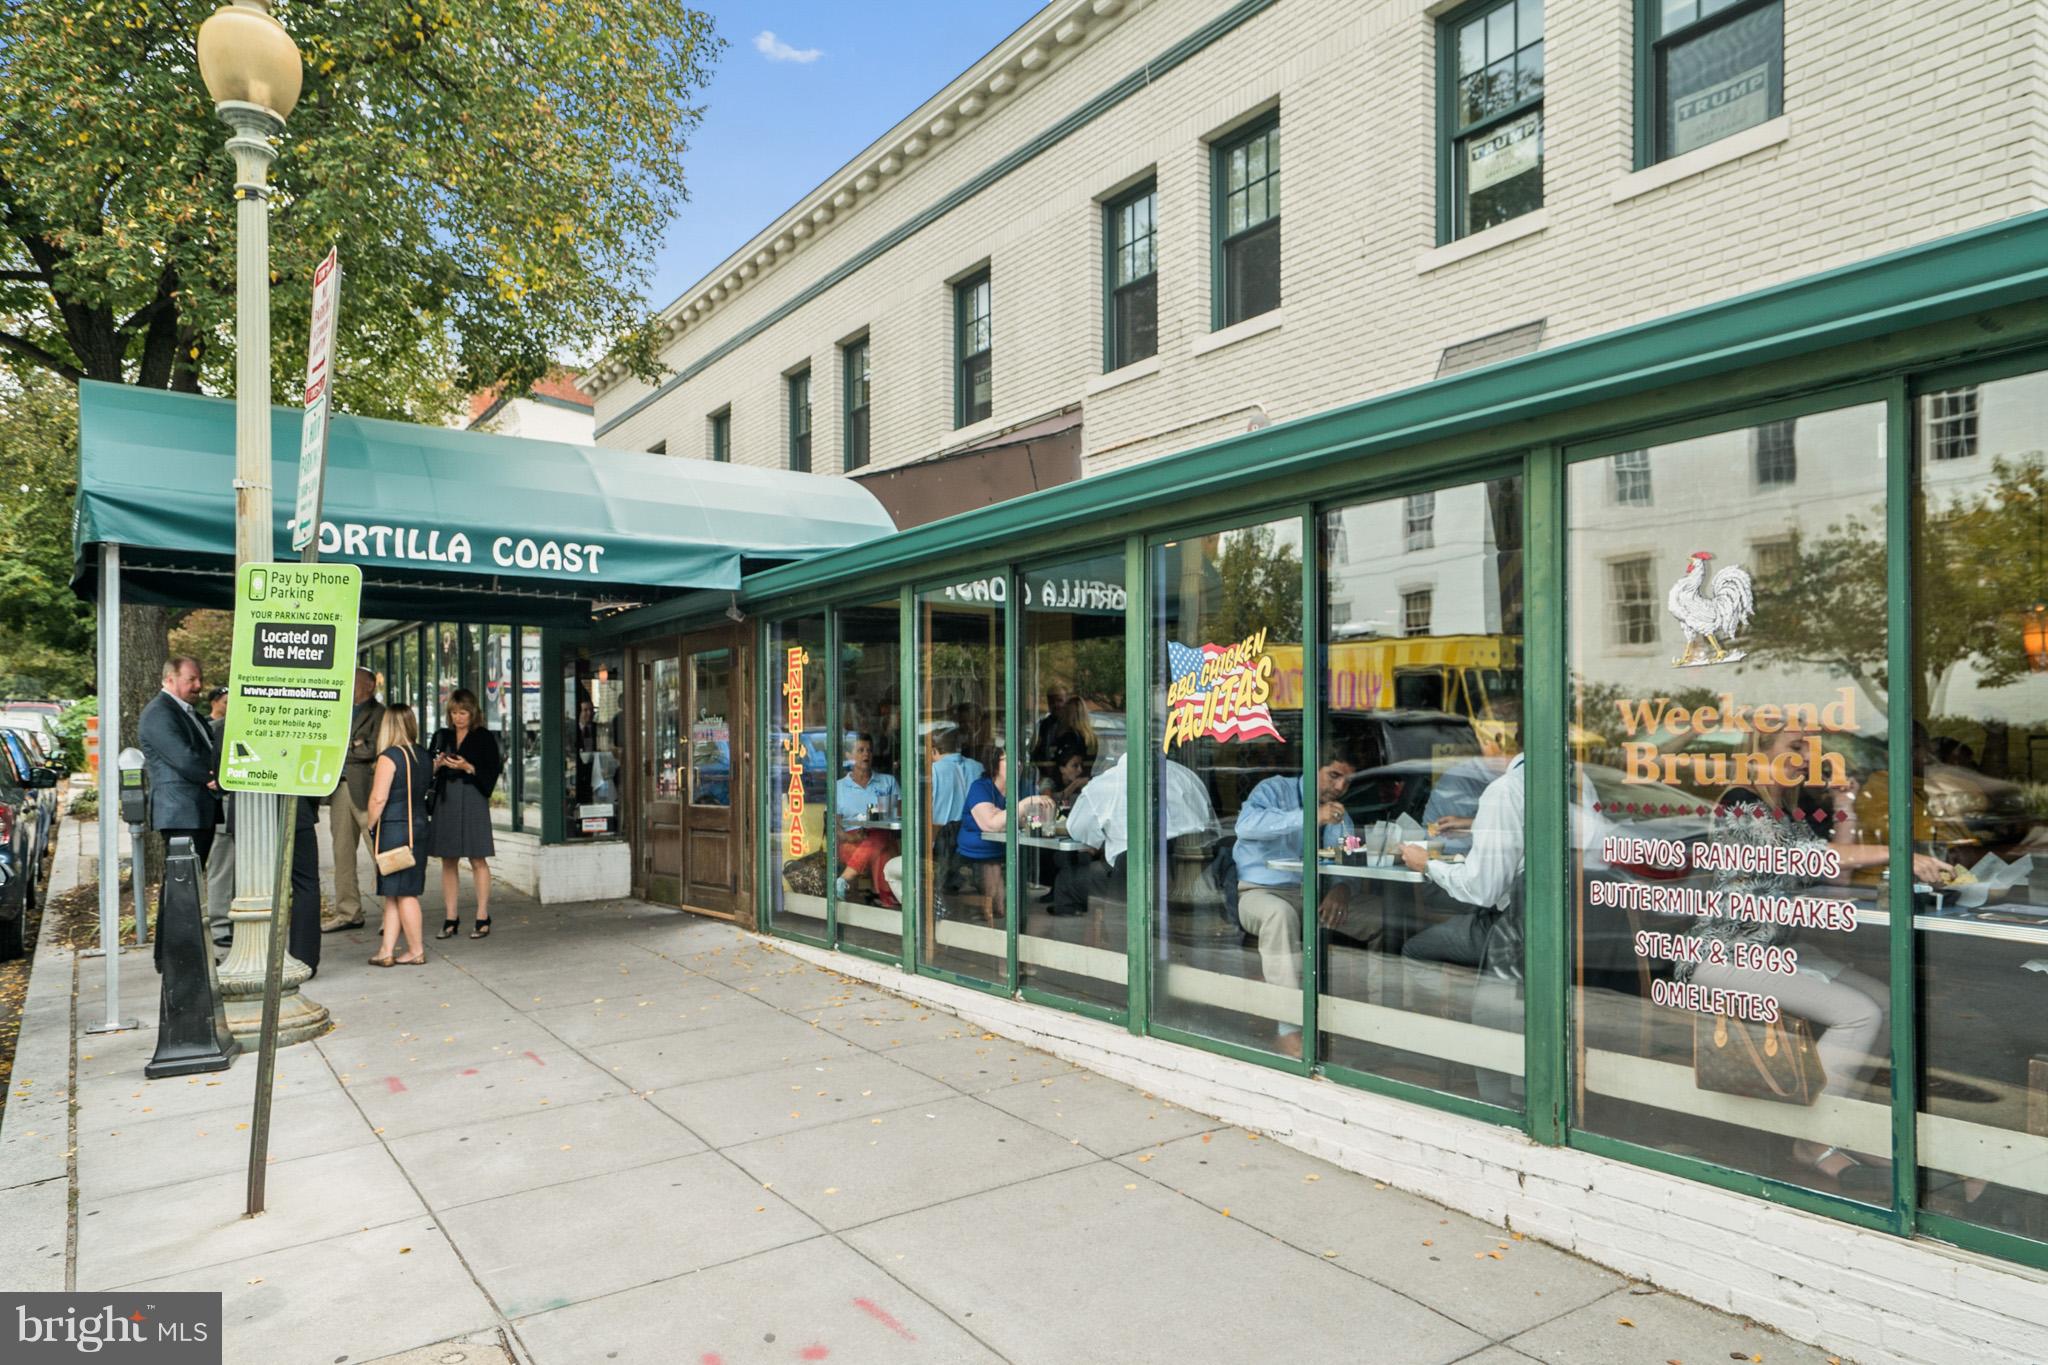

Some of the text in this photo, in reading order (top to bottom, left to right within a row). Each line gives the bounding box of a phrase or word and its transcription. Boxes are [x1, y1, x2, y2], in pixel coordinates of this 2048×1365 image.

[1679, 74, 1763, 119] TRUMP
[1472, 122, 1536, 161] TRUMP
[287, 520, 604, 574] ORTILLA COAST
[270, 586, 314, 602] Parking
[271, 571, 350, 586] Pay by Phone
[250, 610, 343, 622] YOUR PARKING ZONE#:
[261, 629, 328, 645] Located on
[263, 645, 324, 661] the Meter
[237, 674, 264, 683] Register
[266, 675, 286, 683] online
[296, 676, 306, 684] via
[307, 677, 330, 685] mobile
[1167, 671, 1197, 707] BBQ
[1200, 626, 1268, 687] CHICKEN
[243, 686, 338, 699] www.parkmobile.com
[247, 703, 332, 719] To pay for parking:
[1163, 655, 1272, 755] FAJITAS
[1615, 686, 1861, 736] Weekend
[253, 718, 267, 726] Use
[282, 719, 306, 727] Mobile
[307, 720, 322, 729] App
[254, 729, 268, 737] Call
[787, 646, 804, 857] ENCHILADAS
[1621, 735, 1852, 789] Brunch
[1603, 836, 1841, 880] HUEVOS RANCHEROS
[1589, 880, 1858, 931] BUTTERMILK PANCAKES
[1634, 930, 1798, 976] STEAK & EGGS
[1651, 978, 1779, 1023] OMELETTES
